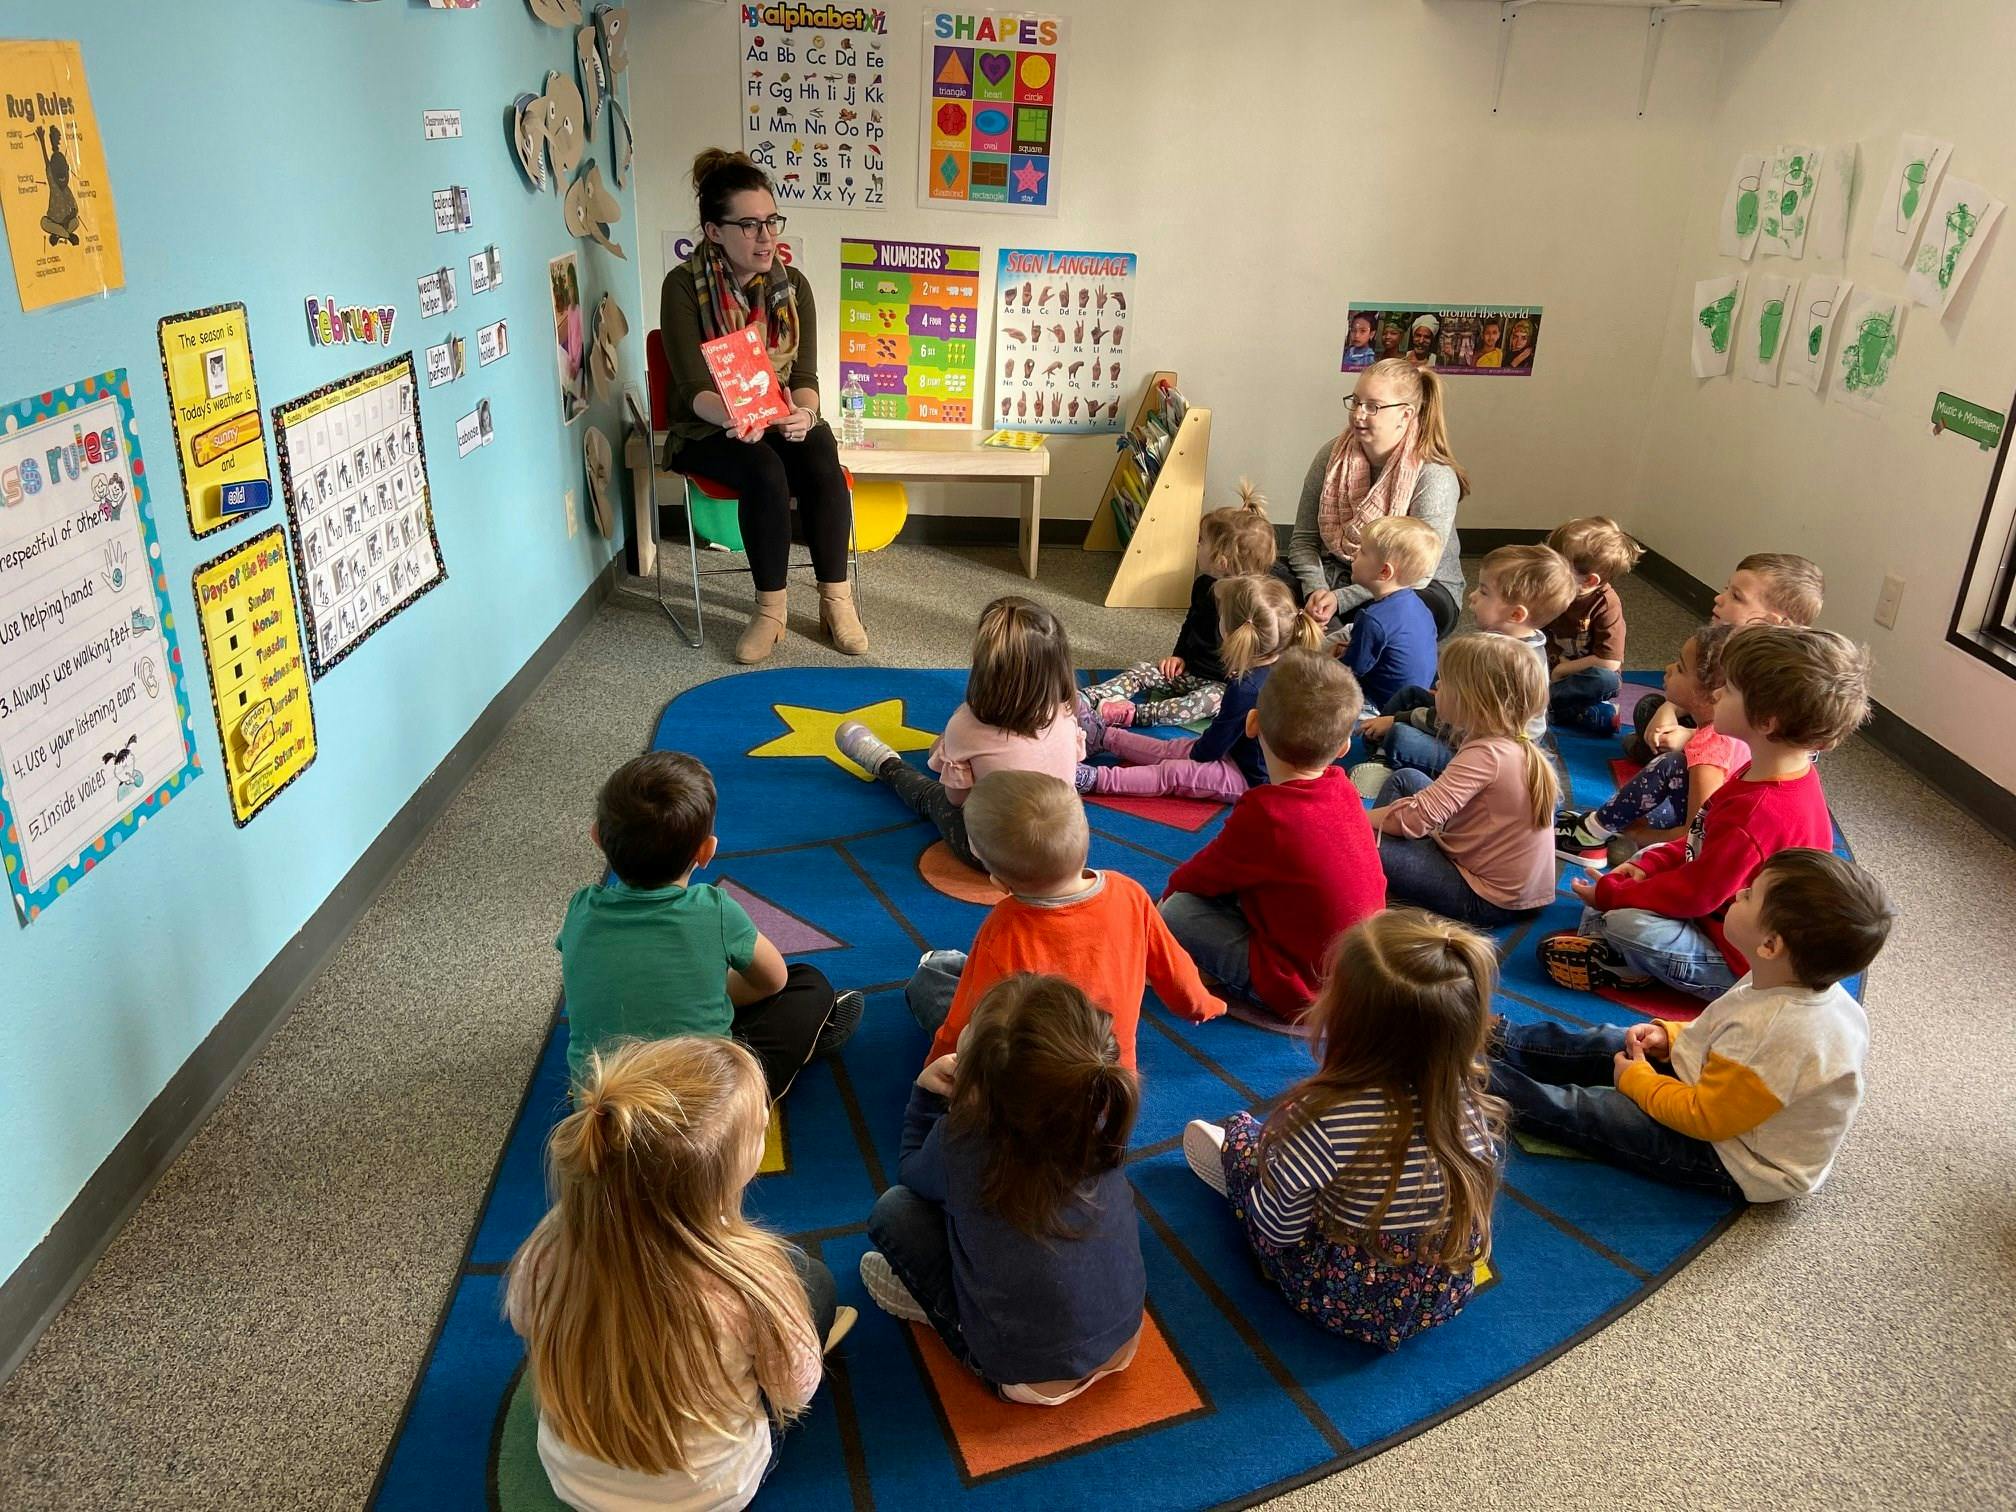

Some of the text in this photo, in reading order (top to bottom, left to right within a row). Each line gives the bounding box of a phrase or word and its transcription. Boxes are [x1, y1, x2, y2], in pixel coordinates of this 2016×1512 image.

[763, 2, 865, 32] alphabet
[935, 13, 1058, 46] SHAPES
[746, 46, 884, 68] Aa Bb Cc Dd Ee
[748, 80, 762, 96] Ff
[769, 82, 792, 103] Gg
[800, 84, 819, 99] Hh
[844, 86, 855, 105] Jj
[865, 87, 884, 103] Kk
[939, 87, 1043, 101] triangle heart circle
[6, 92, 75, 123] Rug Rules
[769, 117, 796, 133] Mm
[805, 119, 826, 135] Nn
[835, 121, 859, 136] Oo
[866, 123, 884, 142] Pp
[983, 142, 1043, 154] oval square
[750, 150, 883, 171] Qq Rr Ss Tt Uu
[776, 183, 883, 206] Ww Xx Yy Zz
[972, 191, 1005, 201] rectangle
[1021, 194, 1035, 203] star
[881, 245, 941, 269] NUMBERS
[922, 282, 929, 296] 2
[421, 296, 440, 315] helper
[849, 308, 856, 323] 3
[1439, 306, 1529, 319] around the world
[306, 296, 396, 346] February
[922, 313, 942, 328] 4 FOUR
[178, 323, 234, 349] The season is
[707, 343, 729, 353] Green
[849, 339, 855, 353] 5
[430, 348, 446, 368] light
[920, 344, 927, 358] 6
[429, 365, 451, 386] person
[919, 374, 926, 388] 8
[180, 386, 252, 422] Today's weather is
[919, 404, 928, 417] 10
[1937, 401, 2001, 434] Music Movement
[213, 425, 240, 447] sunny
[458, 425, 479, 447] caboose
[46, 424, 119, 485] rules
[221, 454, 236, 471] and
[327, 483, 333, 496] 3
[364, 462, 370, 475] 5
[228, 486, 245, 505] cold
[354, 520, 361, 533] 11
[386, 498, 393, 511] 13
[0, 506, 110, 572] respectful of others
[201, 543, 284, 606] Days of the Week
[248, 586, 275, 612] Sunday
[0, 578, 93, 645] Use helping hands
[252, 608, 283, 638] Monday
[256, 635, 288, 664] Tuesday
[0, 620, 131, 719] 3. Always use walking feet
[261, 655, 301, 691] Wednesday
[12, 682, 136, 779] 4. Use your listening ears
[274, 736, 306, 771] Saturday
[39, 792, 76, 833] Inside
[77, 768, 107, 804] voices
